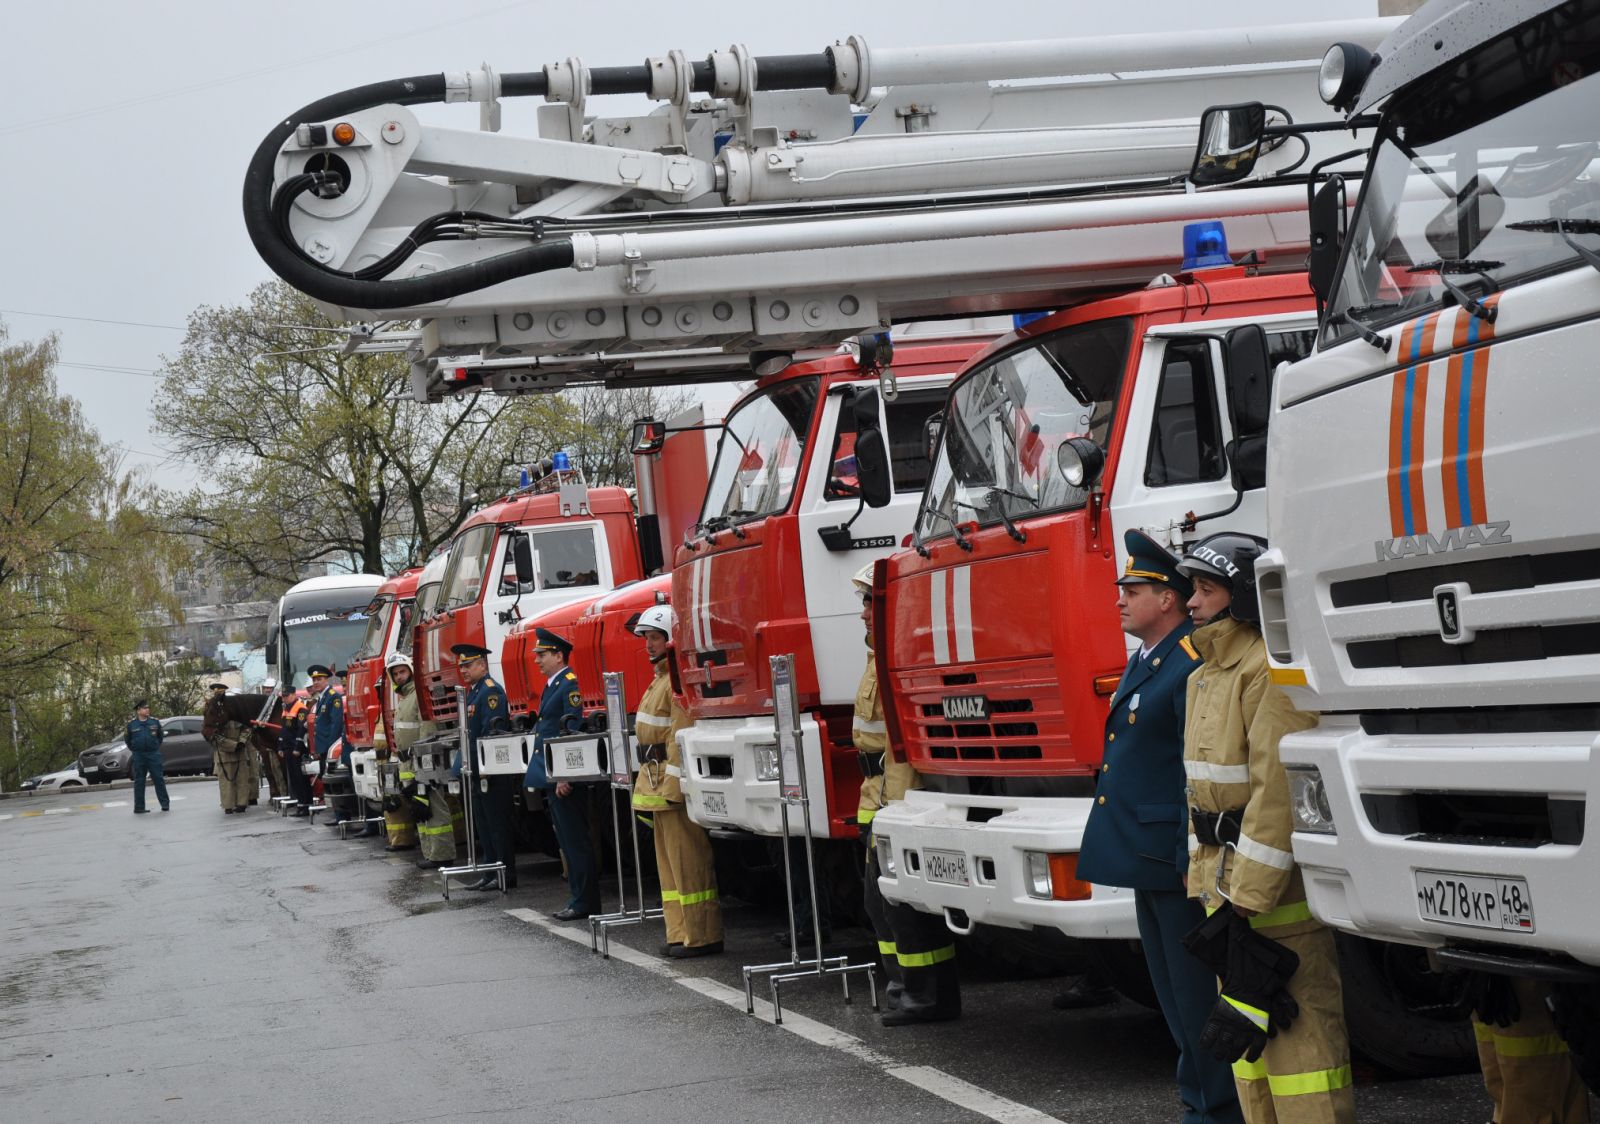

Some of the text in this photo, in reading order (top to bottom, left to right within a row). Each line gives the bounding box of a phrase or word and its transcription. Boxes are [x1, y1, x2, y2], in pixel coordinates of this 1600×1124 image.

[852, 538, 893, 548] 43502
[1374, 520, 1513, 562] KAMAZ
[1193, 546, 1240, 578] СПСЧ
[654, 612, 664, 622] 2
[942, 697, 986, 719] KAMAZ
[1501, 884, 1523, 914] 48
[1503, 913, 1520, 926] RUS
